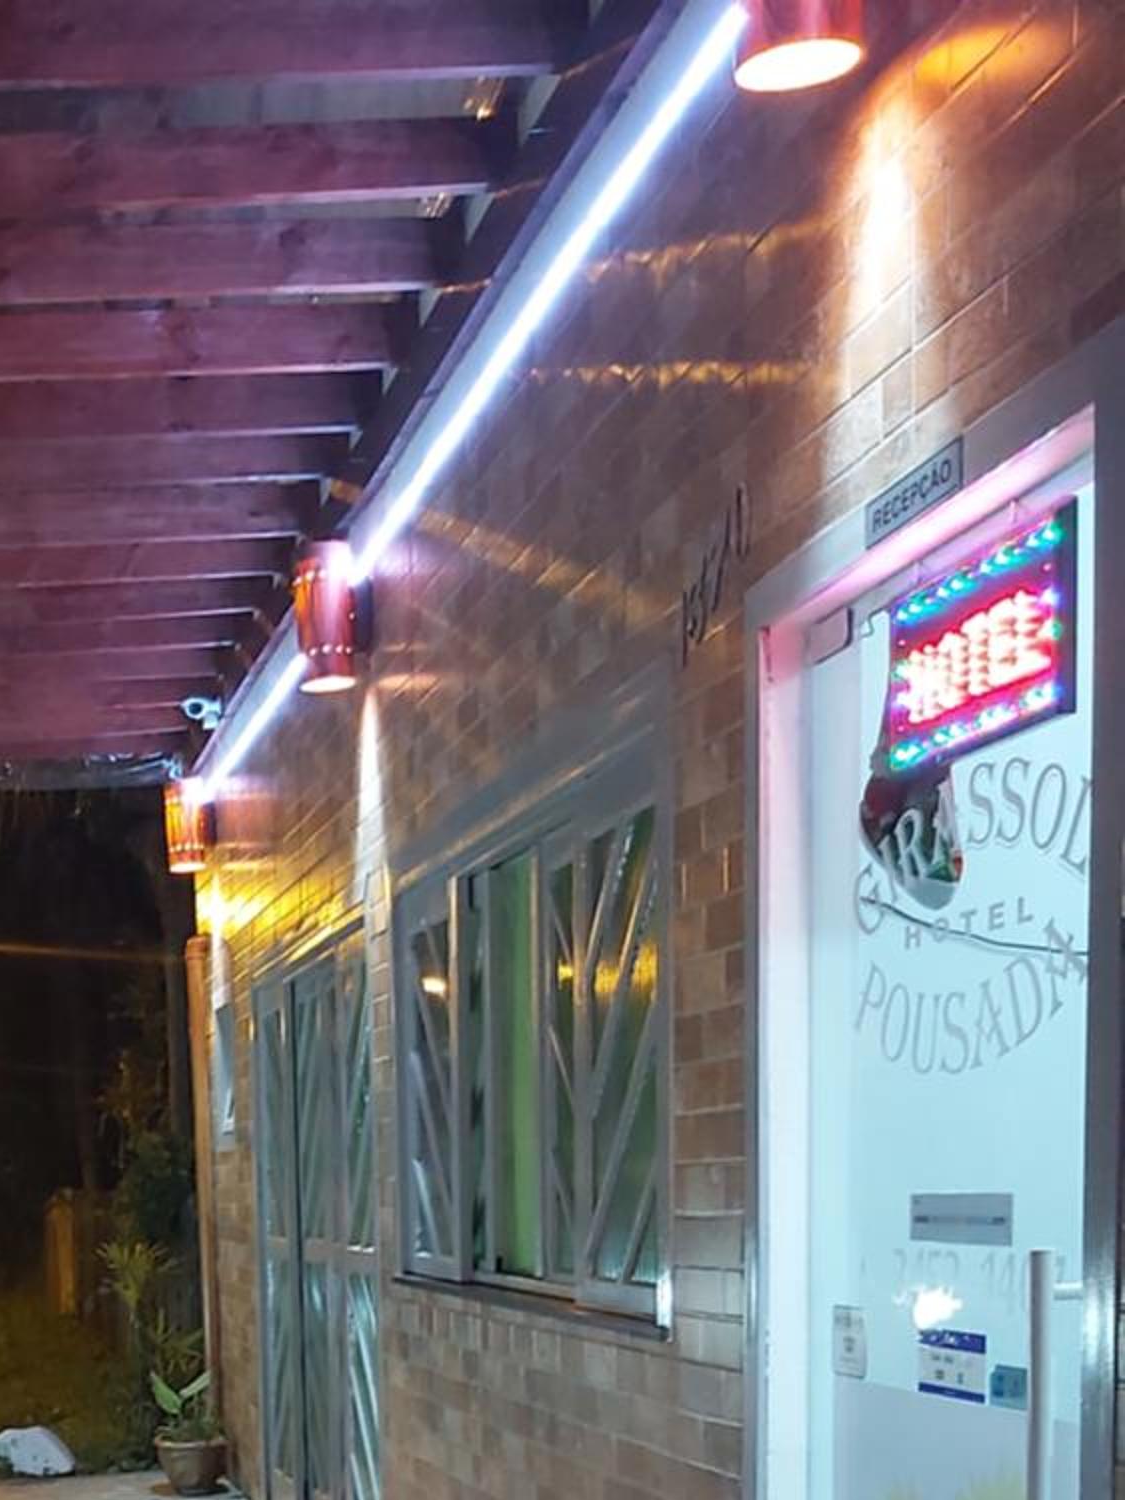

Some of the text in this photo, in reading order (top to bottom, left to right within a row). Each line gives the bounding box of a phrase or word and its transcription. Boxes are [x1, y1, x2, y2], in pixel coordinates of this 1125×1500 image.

[854, 756, 1088, 935] GIRASSOL
[904, 896, 1034, 950] HOTEL
[855, 918, 1088, 1075] POUSADA
